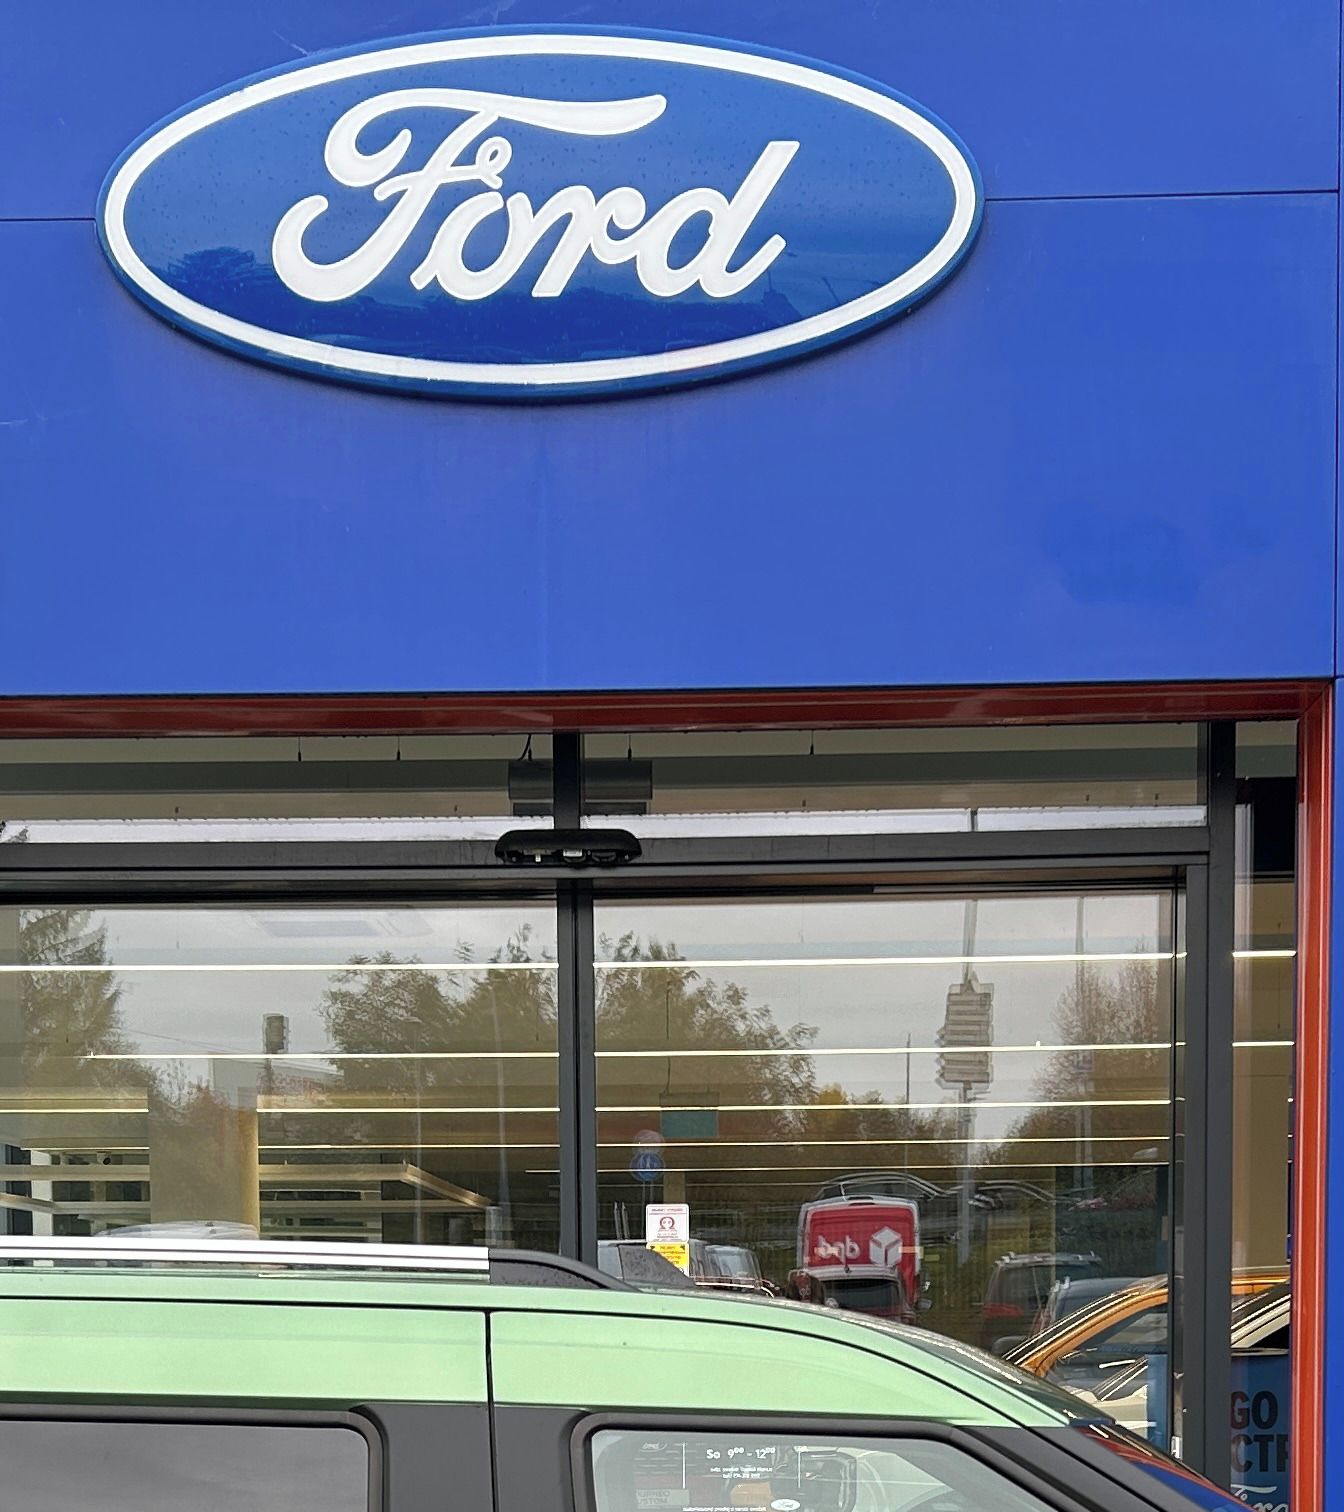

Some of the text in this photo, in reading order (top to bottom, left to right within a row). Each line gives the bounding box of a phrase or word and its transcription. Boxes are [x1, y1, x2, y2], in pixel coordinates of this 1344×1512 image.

[271, 87, 801, 302] Ford
[1231, 1390, 1278, 1430] GO
[706, 1448, 721, 1460] So
